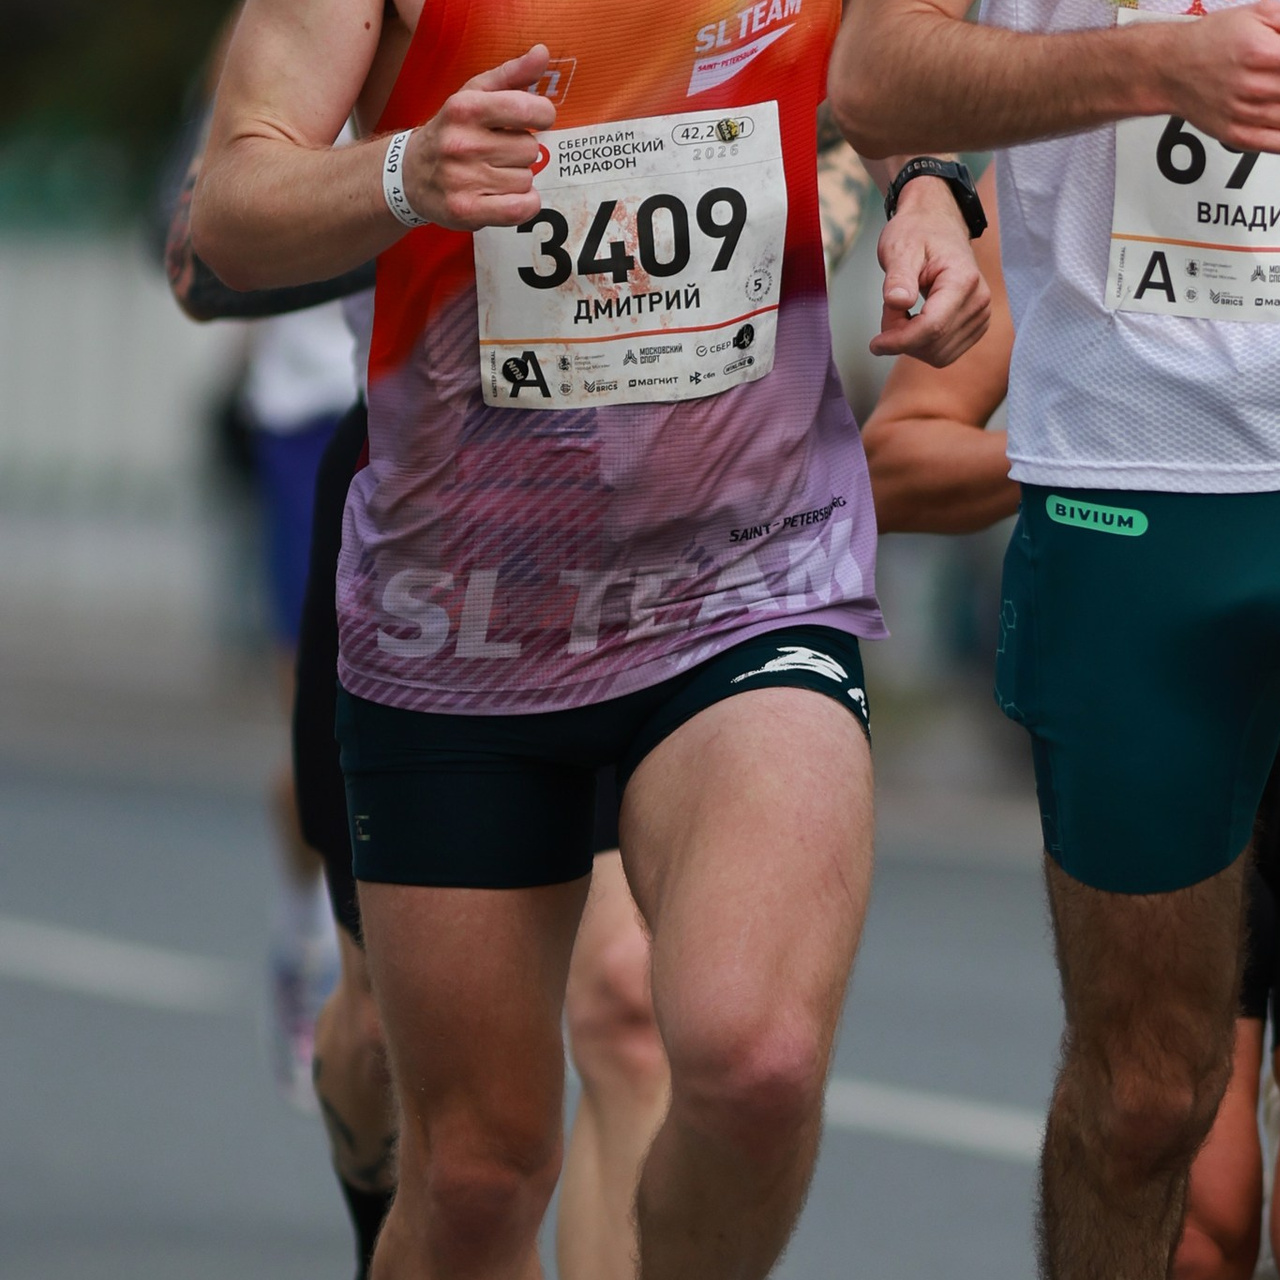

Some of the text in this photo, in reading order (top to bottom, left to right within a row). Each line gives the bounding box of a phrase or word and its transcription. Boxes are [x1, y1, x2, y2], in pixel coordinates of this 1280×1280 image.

[695, 19, 732, 53] SL
[558, 130, 635, 150] СБЕРПРАЙМ
[681, 124, 715, 140] 42,2
[387, 134, 406, 174] 3409
[559, 137, 664, 164] МОСКОВСКИЙ
[692, 143, 740, 161] 2026
[560, 157, 637, 178] МАРАФОН
[516, 187, 748, 290] 3409
[754, 278, 762, 292] 5
[573, 284, 702, 324] ДМИТРИЙ
[1220, 298, 1244, 306] BRICS
[639, 343, 683, 356] МОСКОВСКИЙ
[709, 340, 732, 353] СБЕР
[640, 354, 661, 364] СПОРТ
[507, 361, 524, 381] RUN
[703, 371, 716, 380] сбп
[596, 384, 618, 393] BRICS
[637, 376, 679, 386] магнит
[1055, 503, 1134, 529] BIVIUM
[376, 517, 864, 660] SL TEAM
